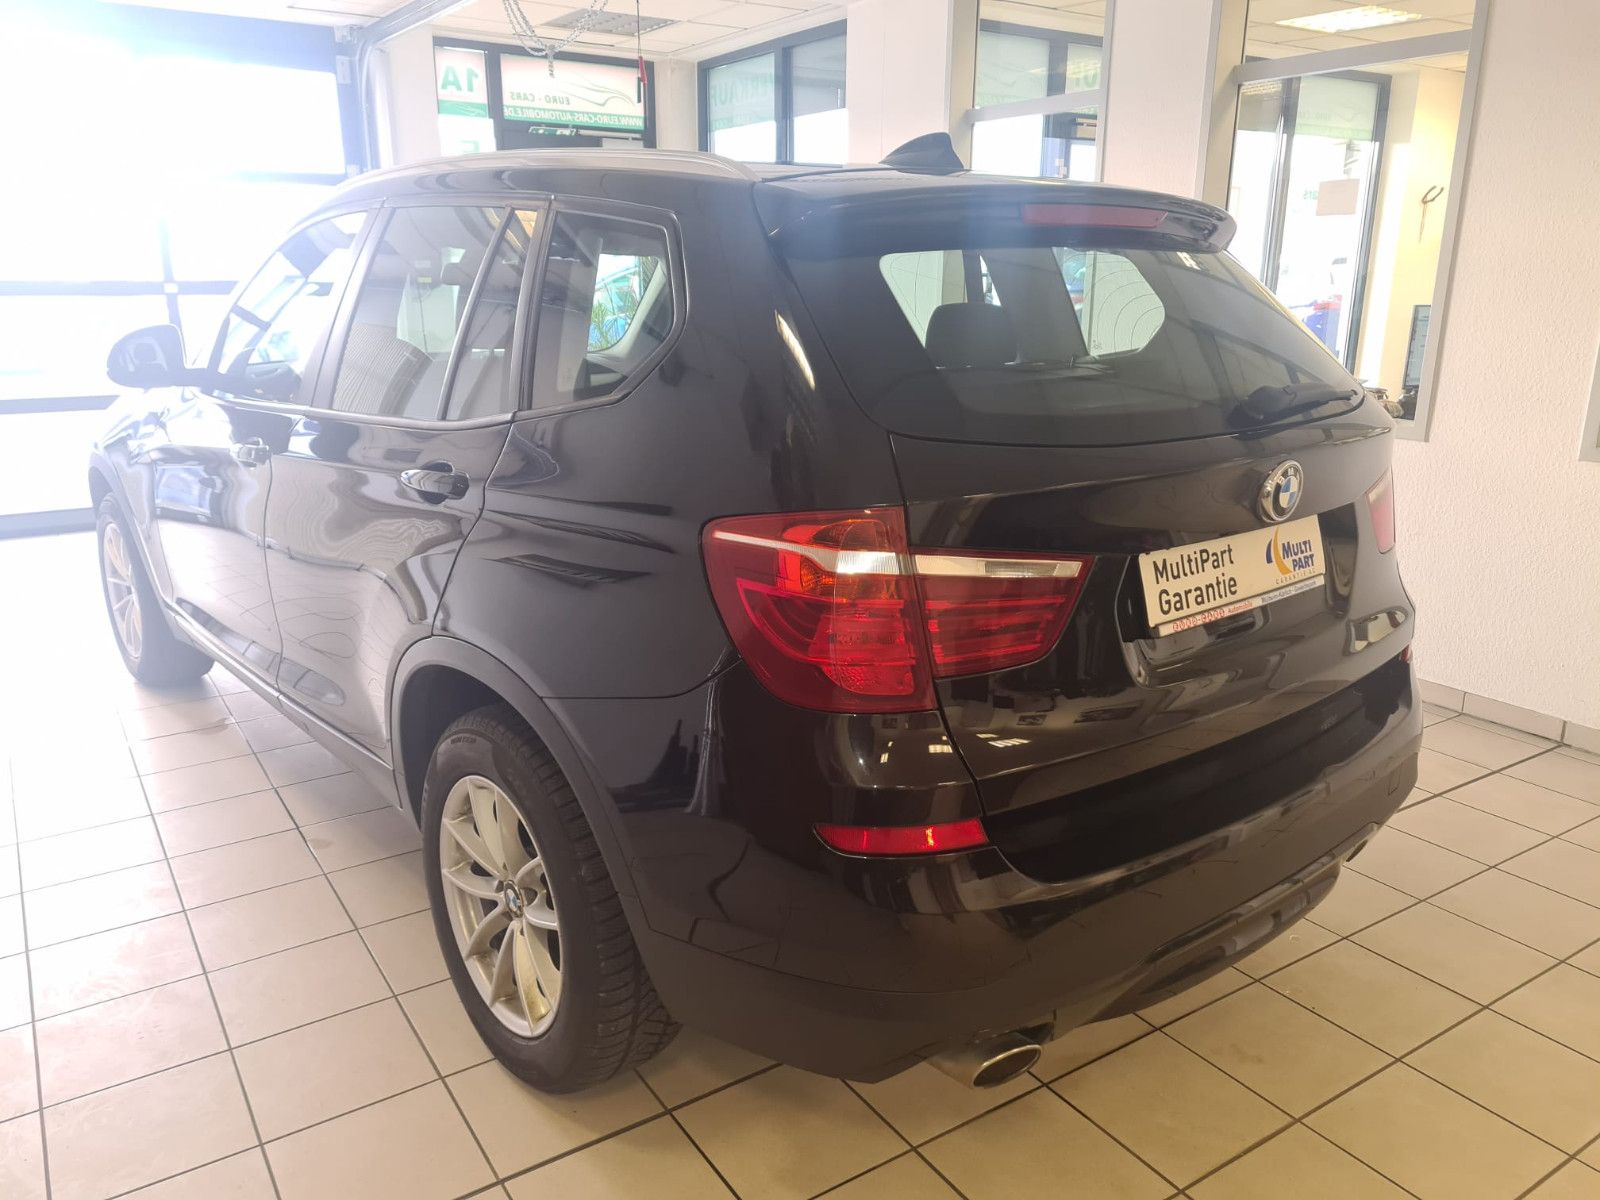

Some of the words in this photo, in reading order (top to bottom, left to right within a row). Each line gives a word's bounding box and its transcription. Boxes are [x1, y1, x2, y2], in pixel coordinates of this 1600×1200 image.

[1152, 544, 1235, 585] MultiPart
[1281, 539, 1312, 560] MULTI
[1291, 553, 1315, 572] PART
[1158, 573, 1238, 616] Garantie
